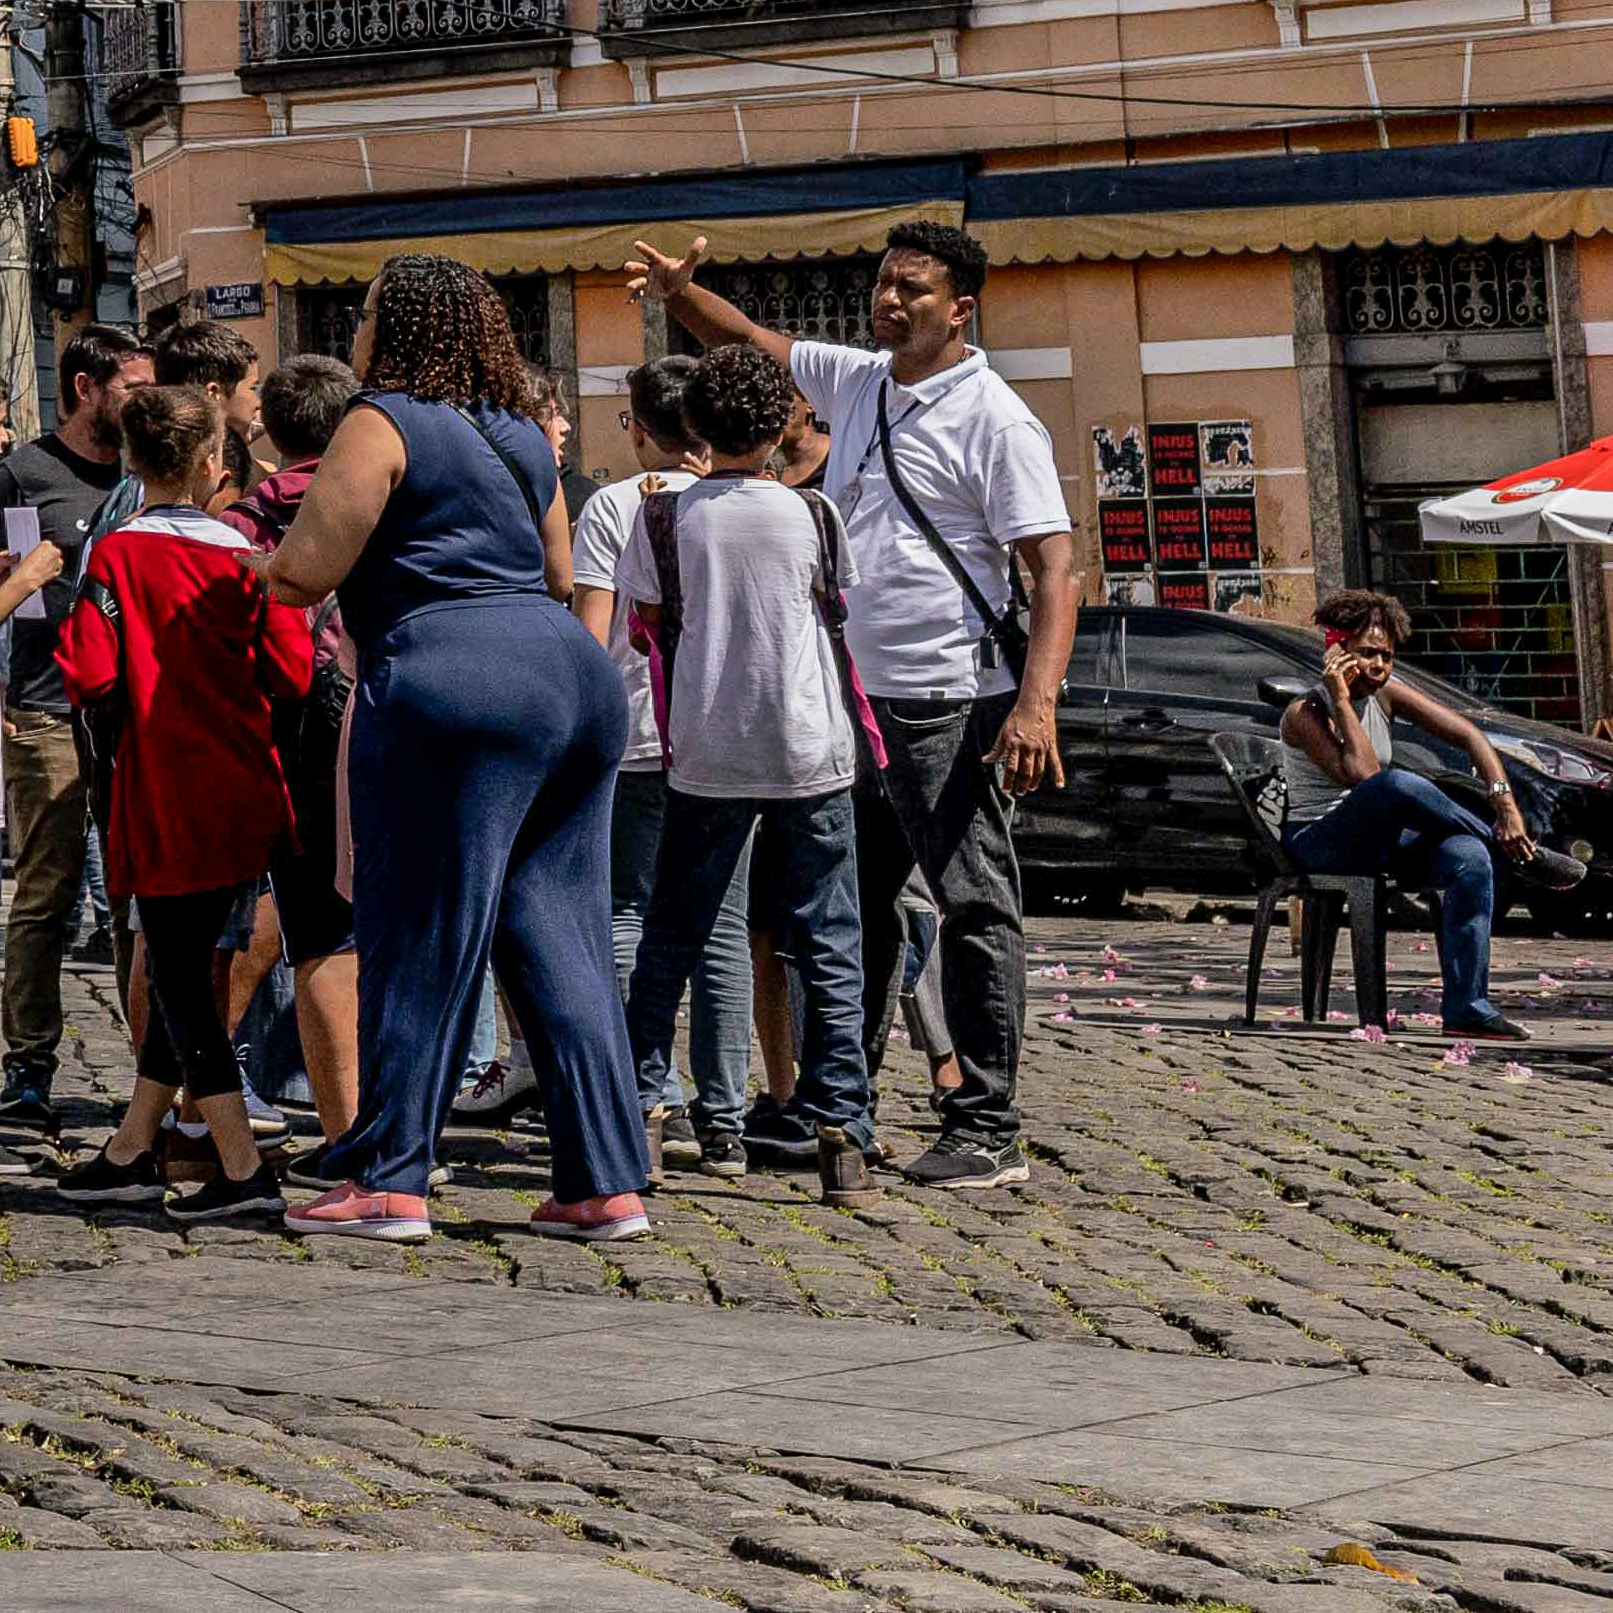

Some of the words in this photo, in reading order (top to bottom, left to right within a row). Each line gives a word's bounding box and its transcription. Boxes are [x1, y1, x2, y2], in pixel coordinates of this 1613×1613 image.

[216, 286, 251, 299] LARGO
[1154, 468, 1197, 484] HELL
[1459, 520, 1504, 535] AMSTEL
[1106, 545, 1146, 561] HELL
[1160, 543, 1202, 559] HELL
[1211, 542, 1254, 559] HELL
